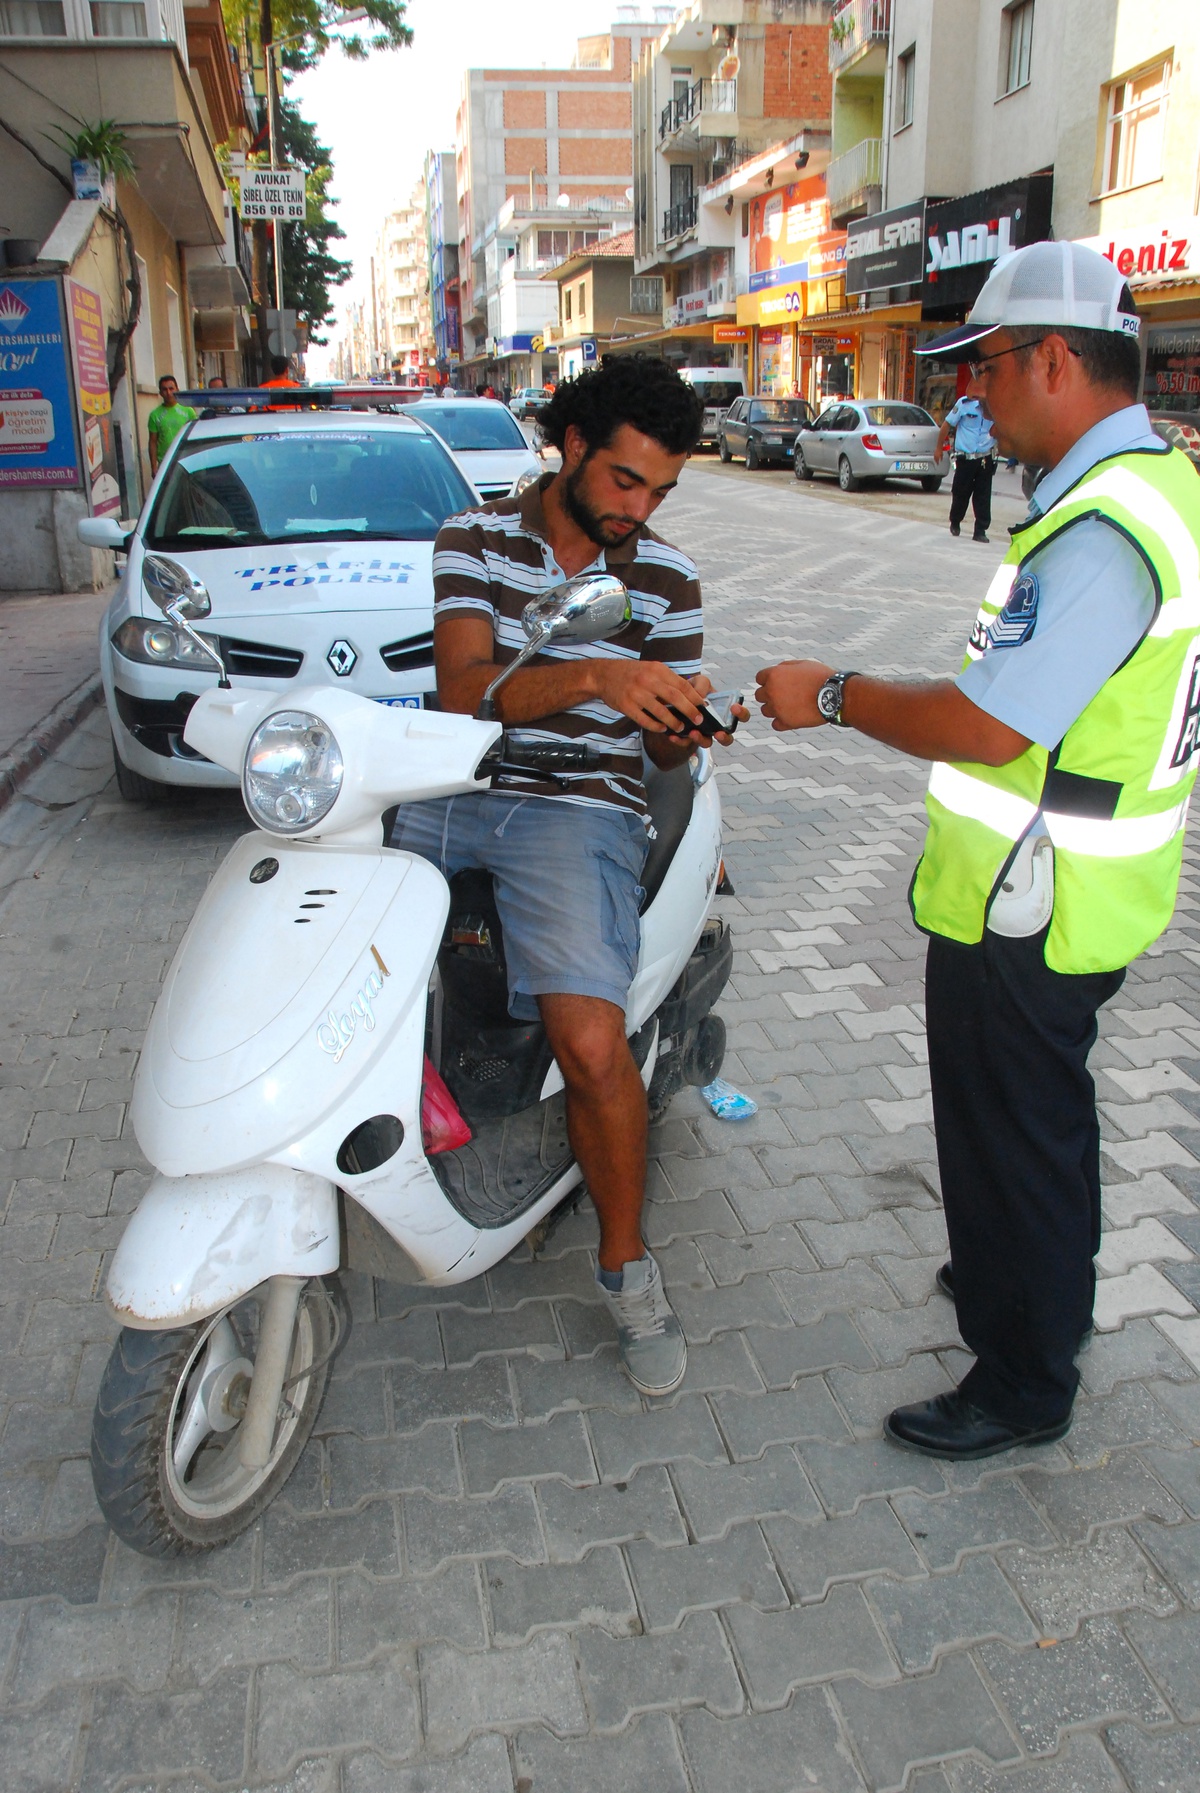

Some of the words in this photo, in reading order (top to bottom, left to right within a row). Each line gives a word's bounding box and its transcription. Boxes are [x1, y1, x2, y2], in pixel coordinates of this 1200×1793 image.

[254, 173, 291, 186] AVUKAT
[243, 186, 263, 203] SİBEL
[264, 187, 282, 203] ÖZEL
[283, 187, 303, 203] TEKİN
[244, 204, 267, 216] 856
[270, 205, 285, 216] 96
[288, 205, 303, 217] 86
[846, 228, 884, 261] ERDAL
[884, 216, 921, 251] SPOR
[1122, 318, 1139, 333] POL
[583, 342, 595, 360] P
[234, 559, 417, 578] TRAFİK
[248, 571, 411, 592] POLİSİ
